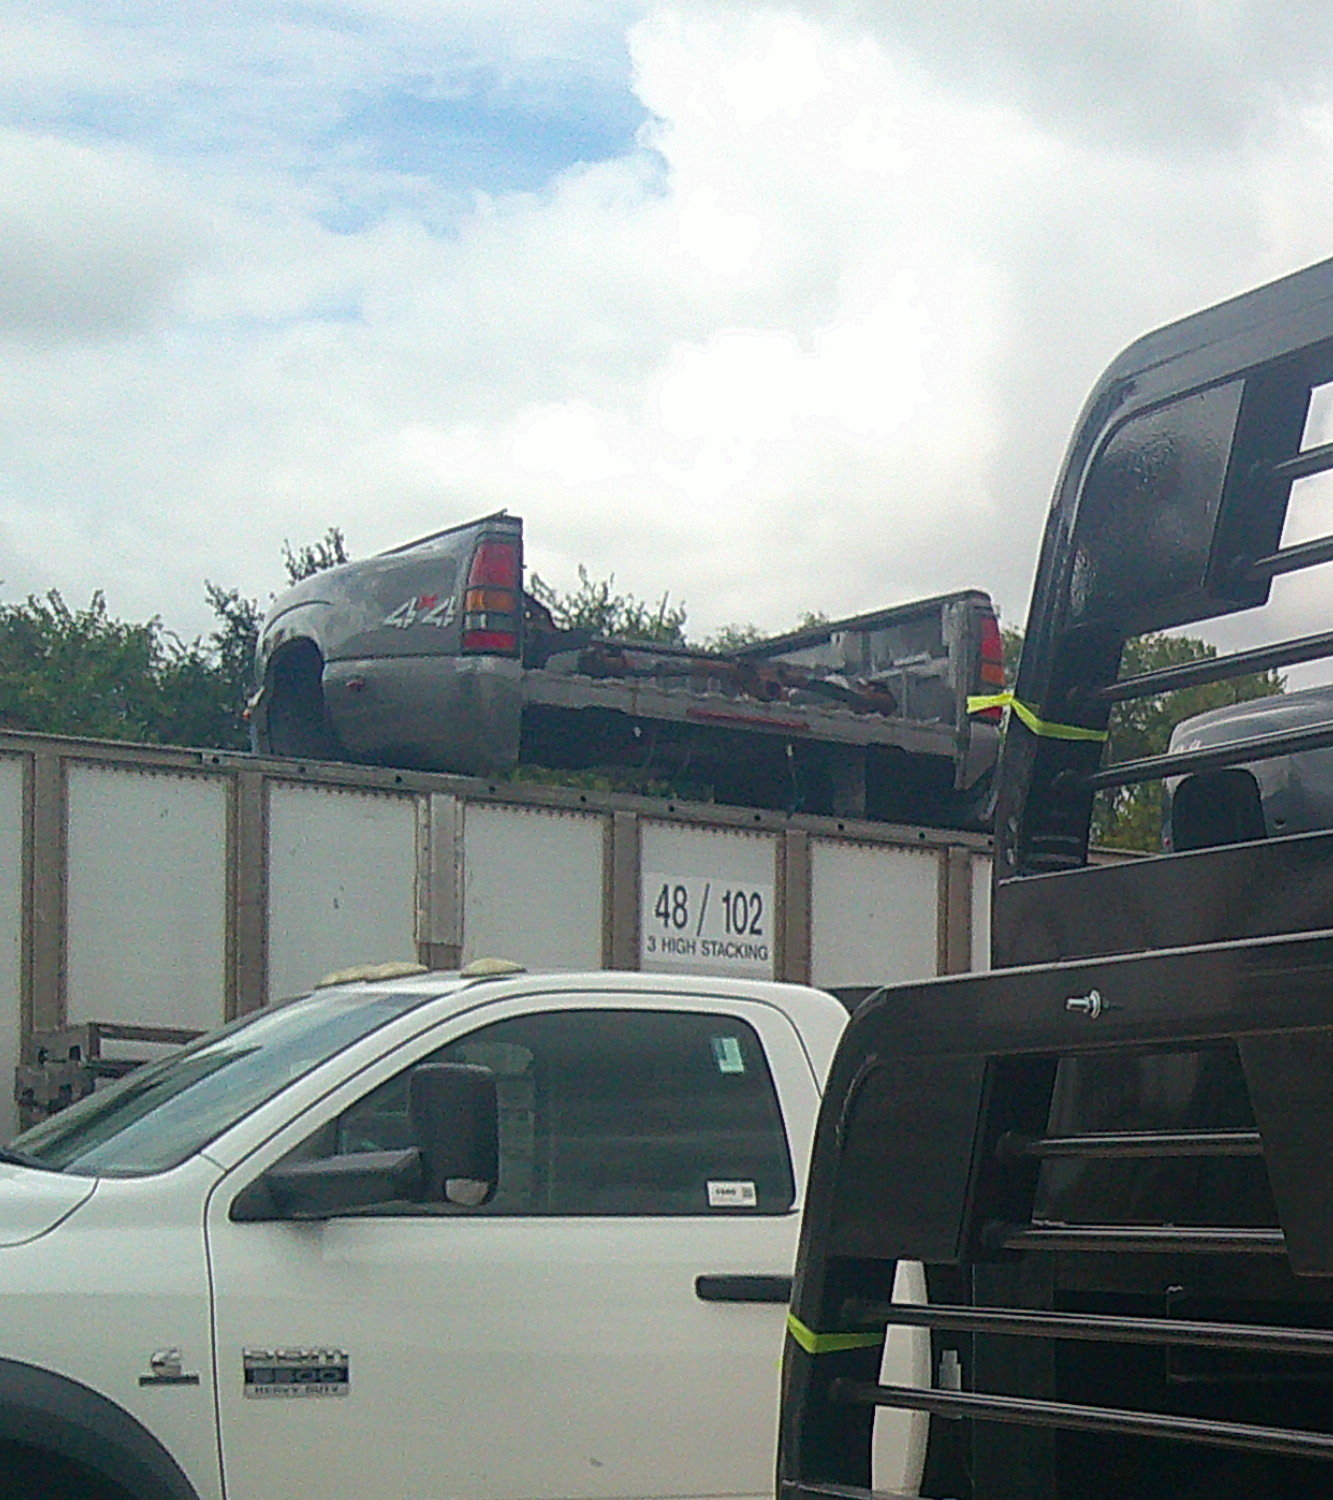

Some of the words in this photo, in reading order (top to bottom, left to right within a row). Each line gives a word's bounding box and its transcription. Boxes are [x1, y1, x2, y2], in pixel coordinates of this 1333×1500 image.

[654, 883, 688, 930] 48
[721, 888, 764, 936] 102
[646, 935, 657, 953] 3
[661, 936, 697, 956] HIGH
[700, 939, 769, 962] STACKING
